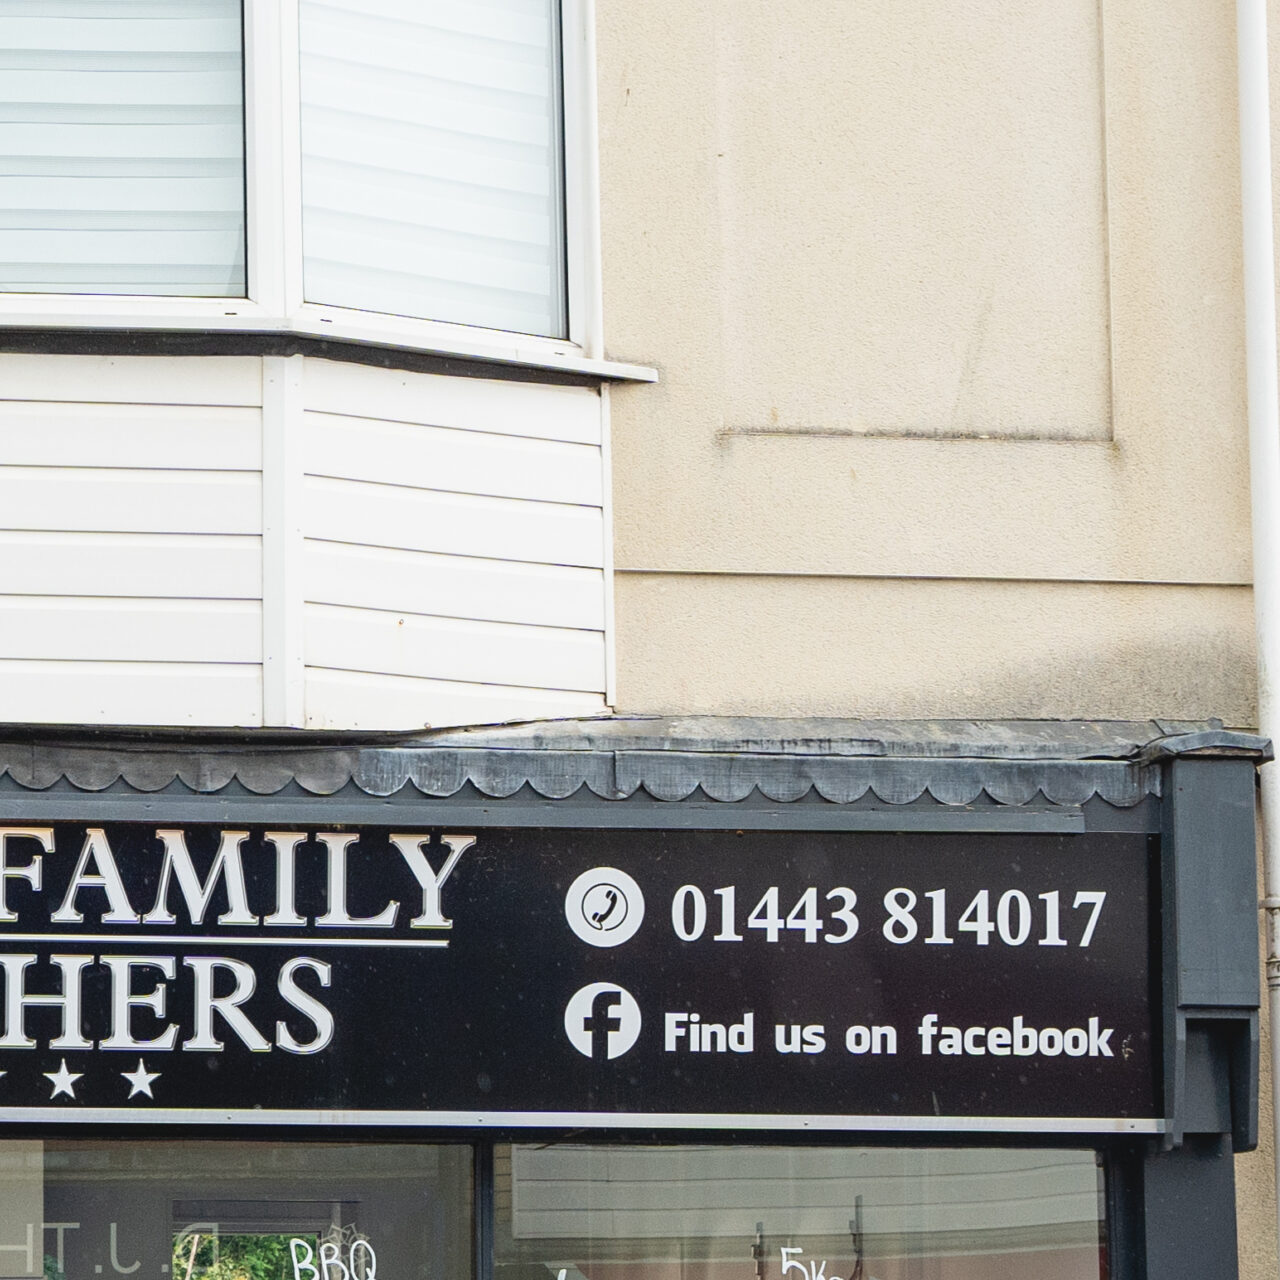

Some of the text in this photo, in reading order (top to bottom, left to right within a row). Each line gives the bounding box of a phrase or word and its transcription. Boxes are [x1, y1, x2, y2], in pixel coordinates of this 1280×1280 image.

[671, 884, 1107, 947] 01443 814017
[664, 1012, 1115, 1058] Find us on facebook
